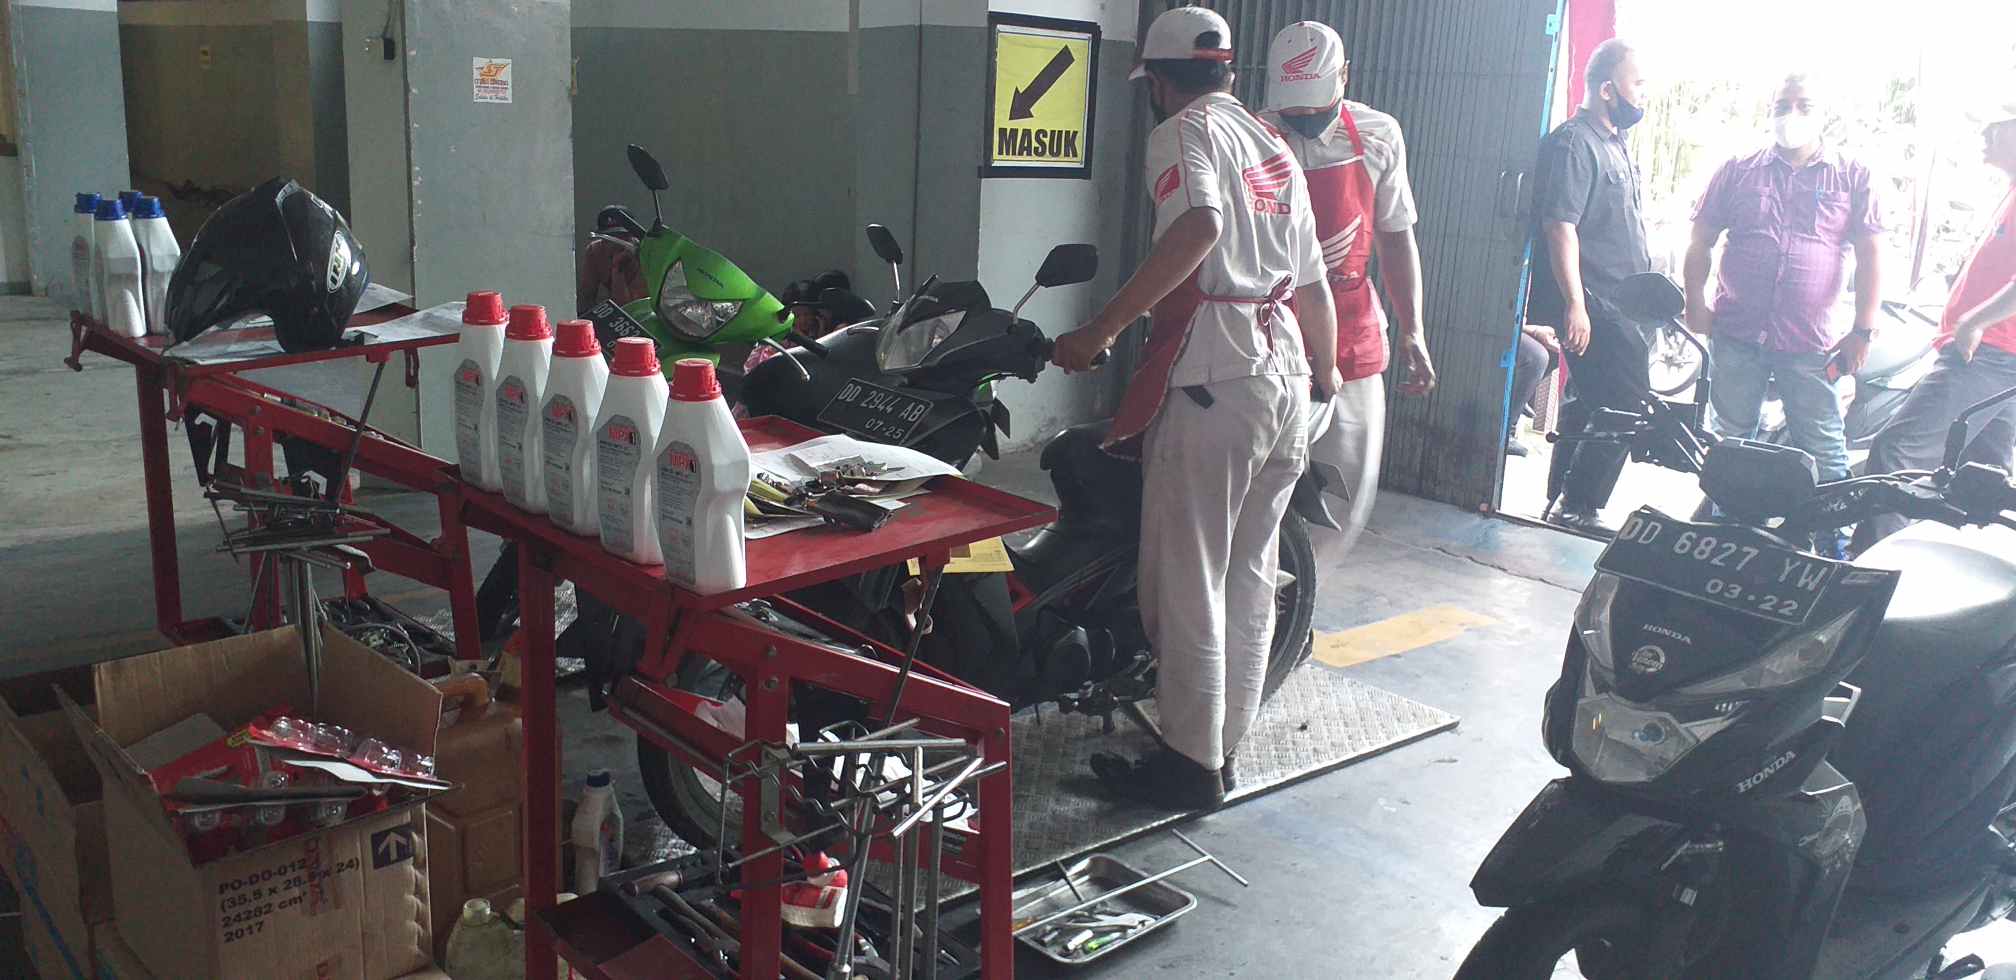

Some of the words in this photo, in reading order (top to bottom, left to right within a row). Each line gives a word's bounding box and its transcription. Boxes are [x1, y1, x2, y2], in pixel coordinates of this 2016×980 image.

[998, 127, 1078, 158] MASUK
[838, 383, 861, 402] DD
[860, 390, 901, 414] 2944
[898, 402, 925, 422] AB
[1619, 517, 1662, 545] DD
[1673, 532, 1759, 571] 6827
[1778, 558, 1828, 592] YW
[1641, 623, 1692, 645] HONDA
[1737, 750, 1796, 793] HONDA
[224, 920, 264, 942] 2017
